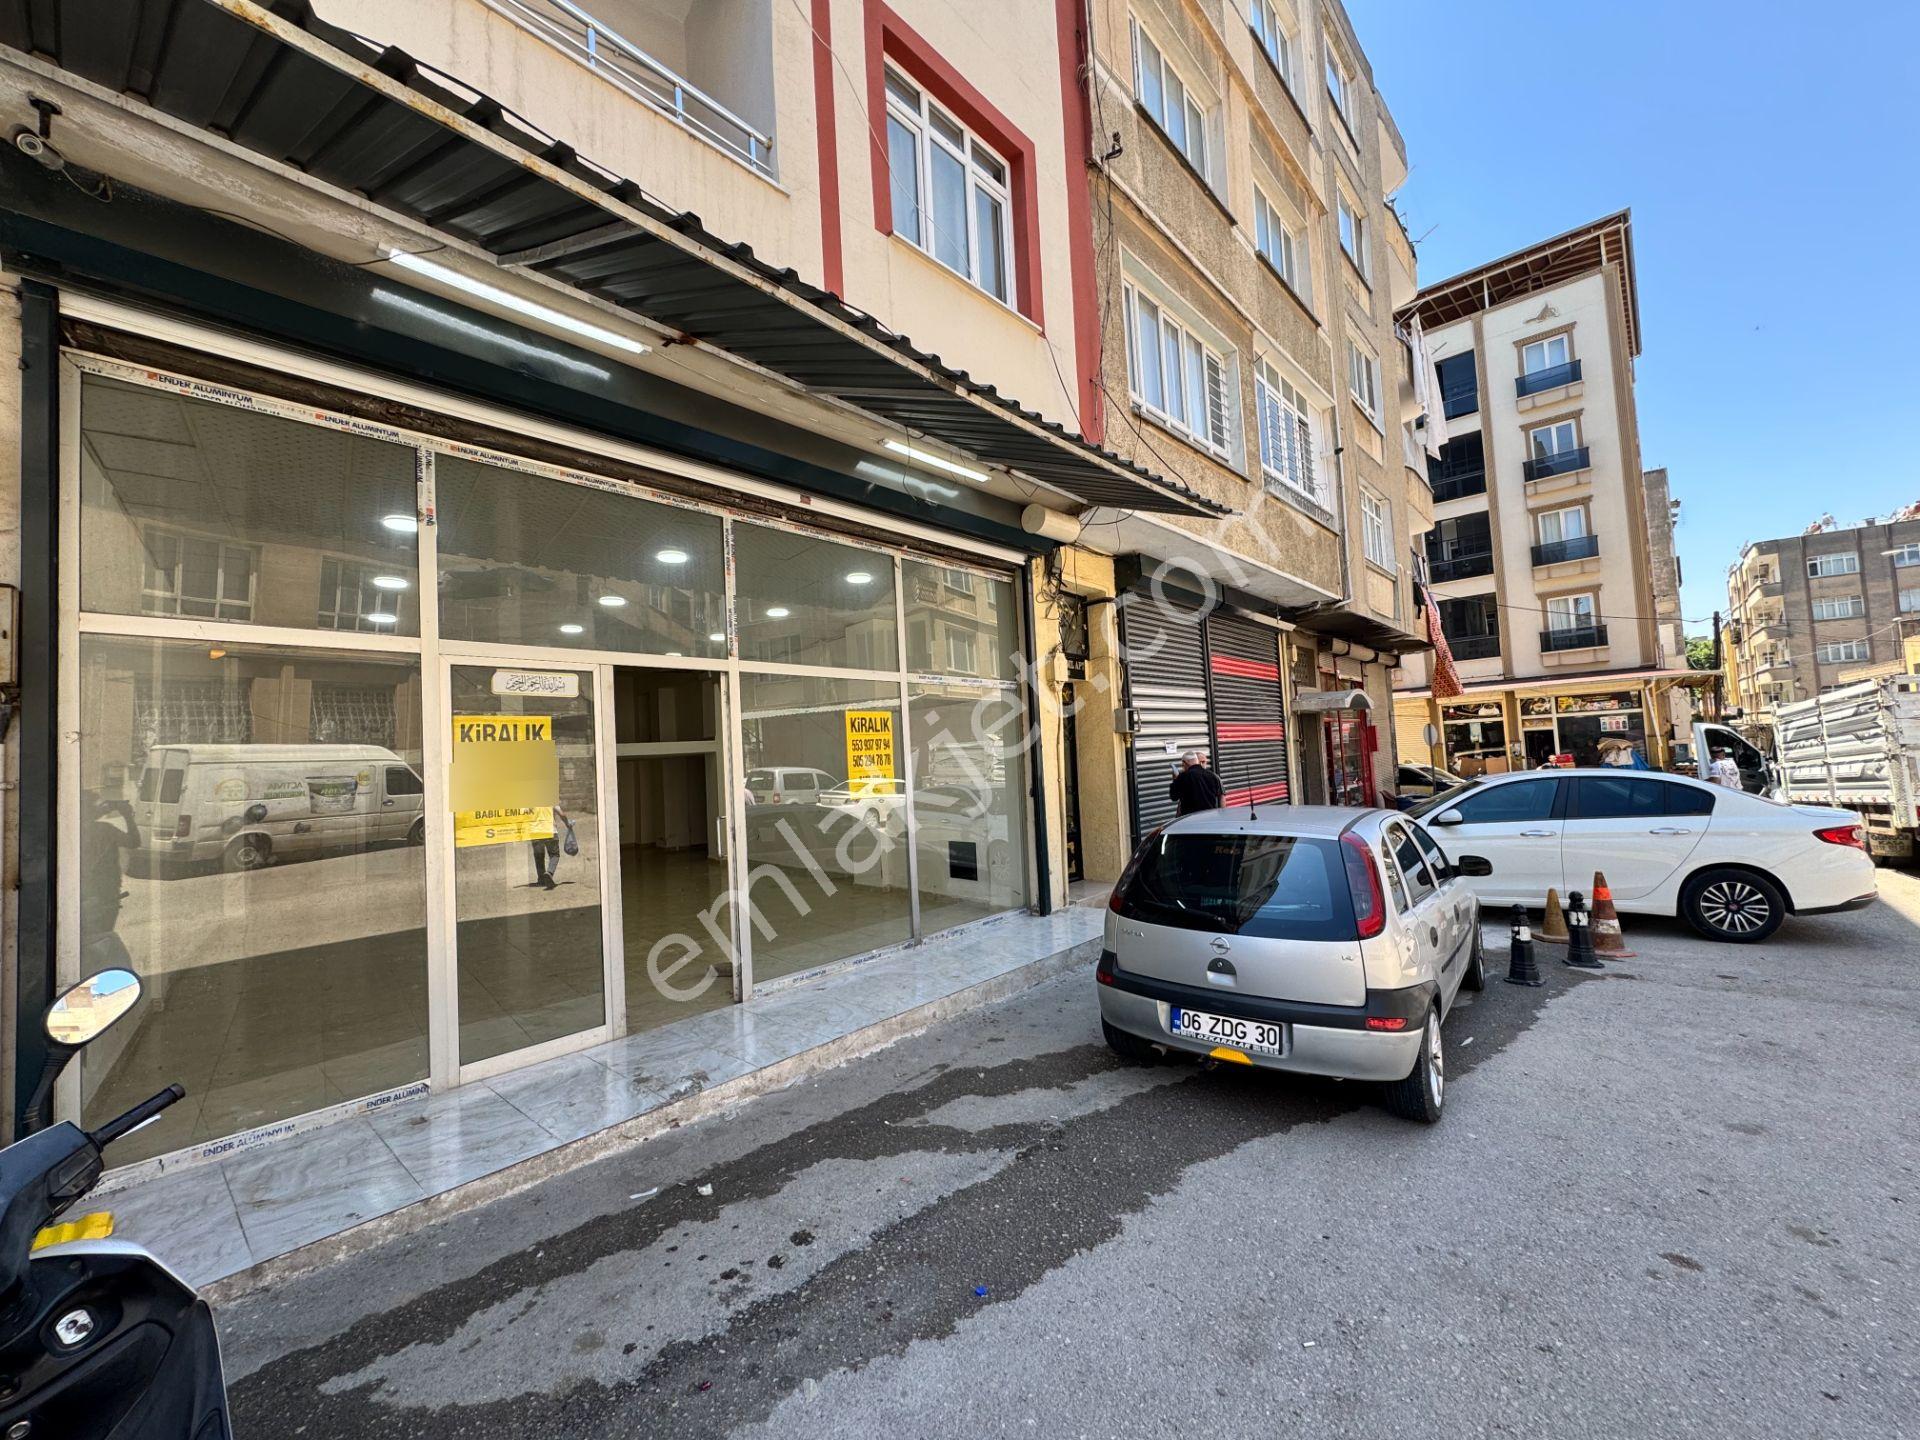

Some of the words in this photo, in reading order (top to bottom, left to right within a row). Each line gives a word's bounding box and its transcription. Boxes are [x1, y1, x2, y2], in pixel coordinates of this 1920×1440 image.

[1182, 1012, 1201, 1031] 06
[1209, 1017, 1247, 1040] ZDG
[1255, 1025, 1278, 1046] 30
[366, 1096, 392, 1109] ENDER
[203, 1142, 235, 1157] ENDER
